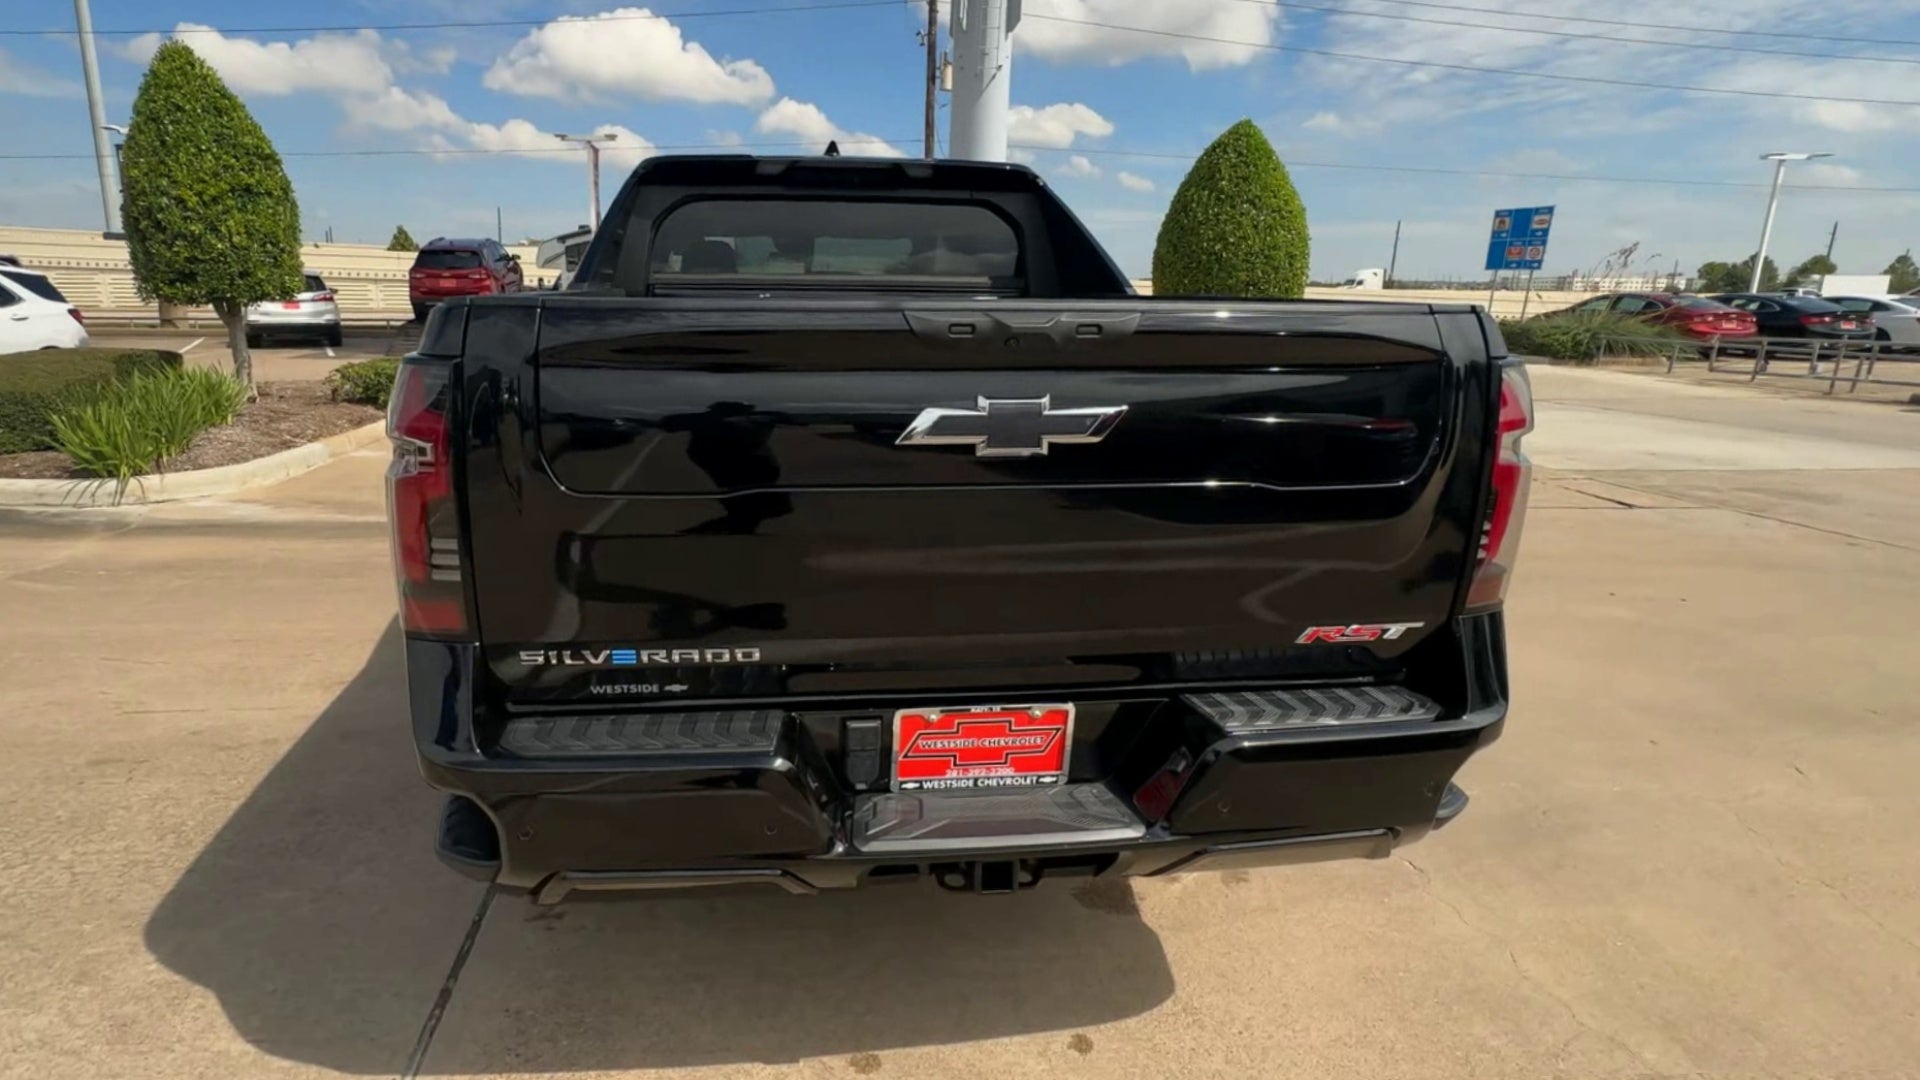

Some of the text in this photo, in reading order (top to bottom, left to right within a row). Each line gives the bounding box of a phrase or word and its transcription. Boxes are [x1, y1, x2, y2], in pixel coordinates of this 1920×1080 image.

[1294, 621, 1425, 644] RST
[519, 648, 761, 665] SILVERADO
[590, 684, 660, 694] WESTSIDE
[921, 736, 1044, 749] WESTSIDE CHEVROLET
[922, 776, 1037, 789] WESTSIDE CHEVROLET
